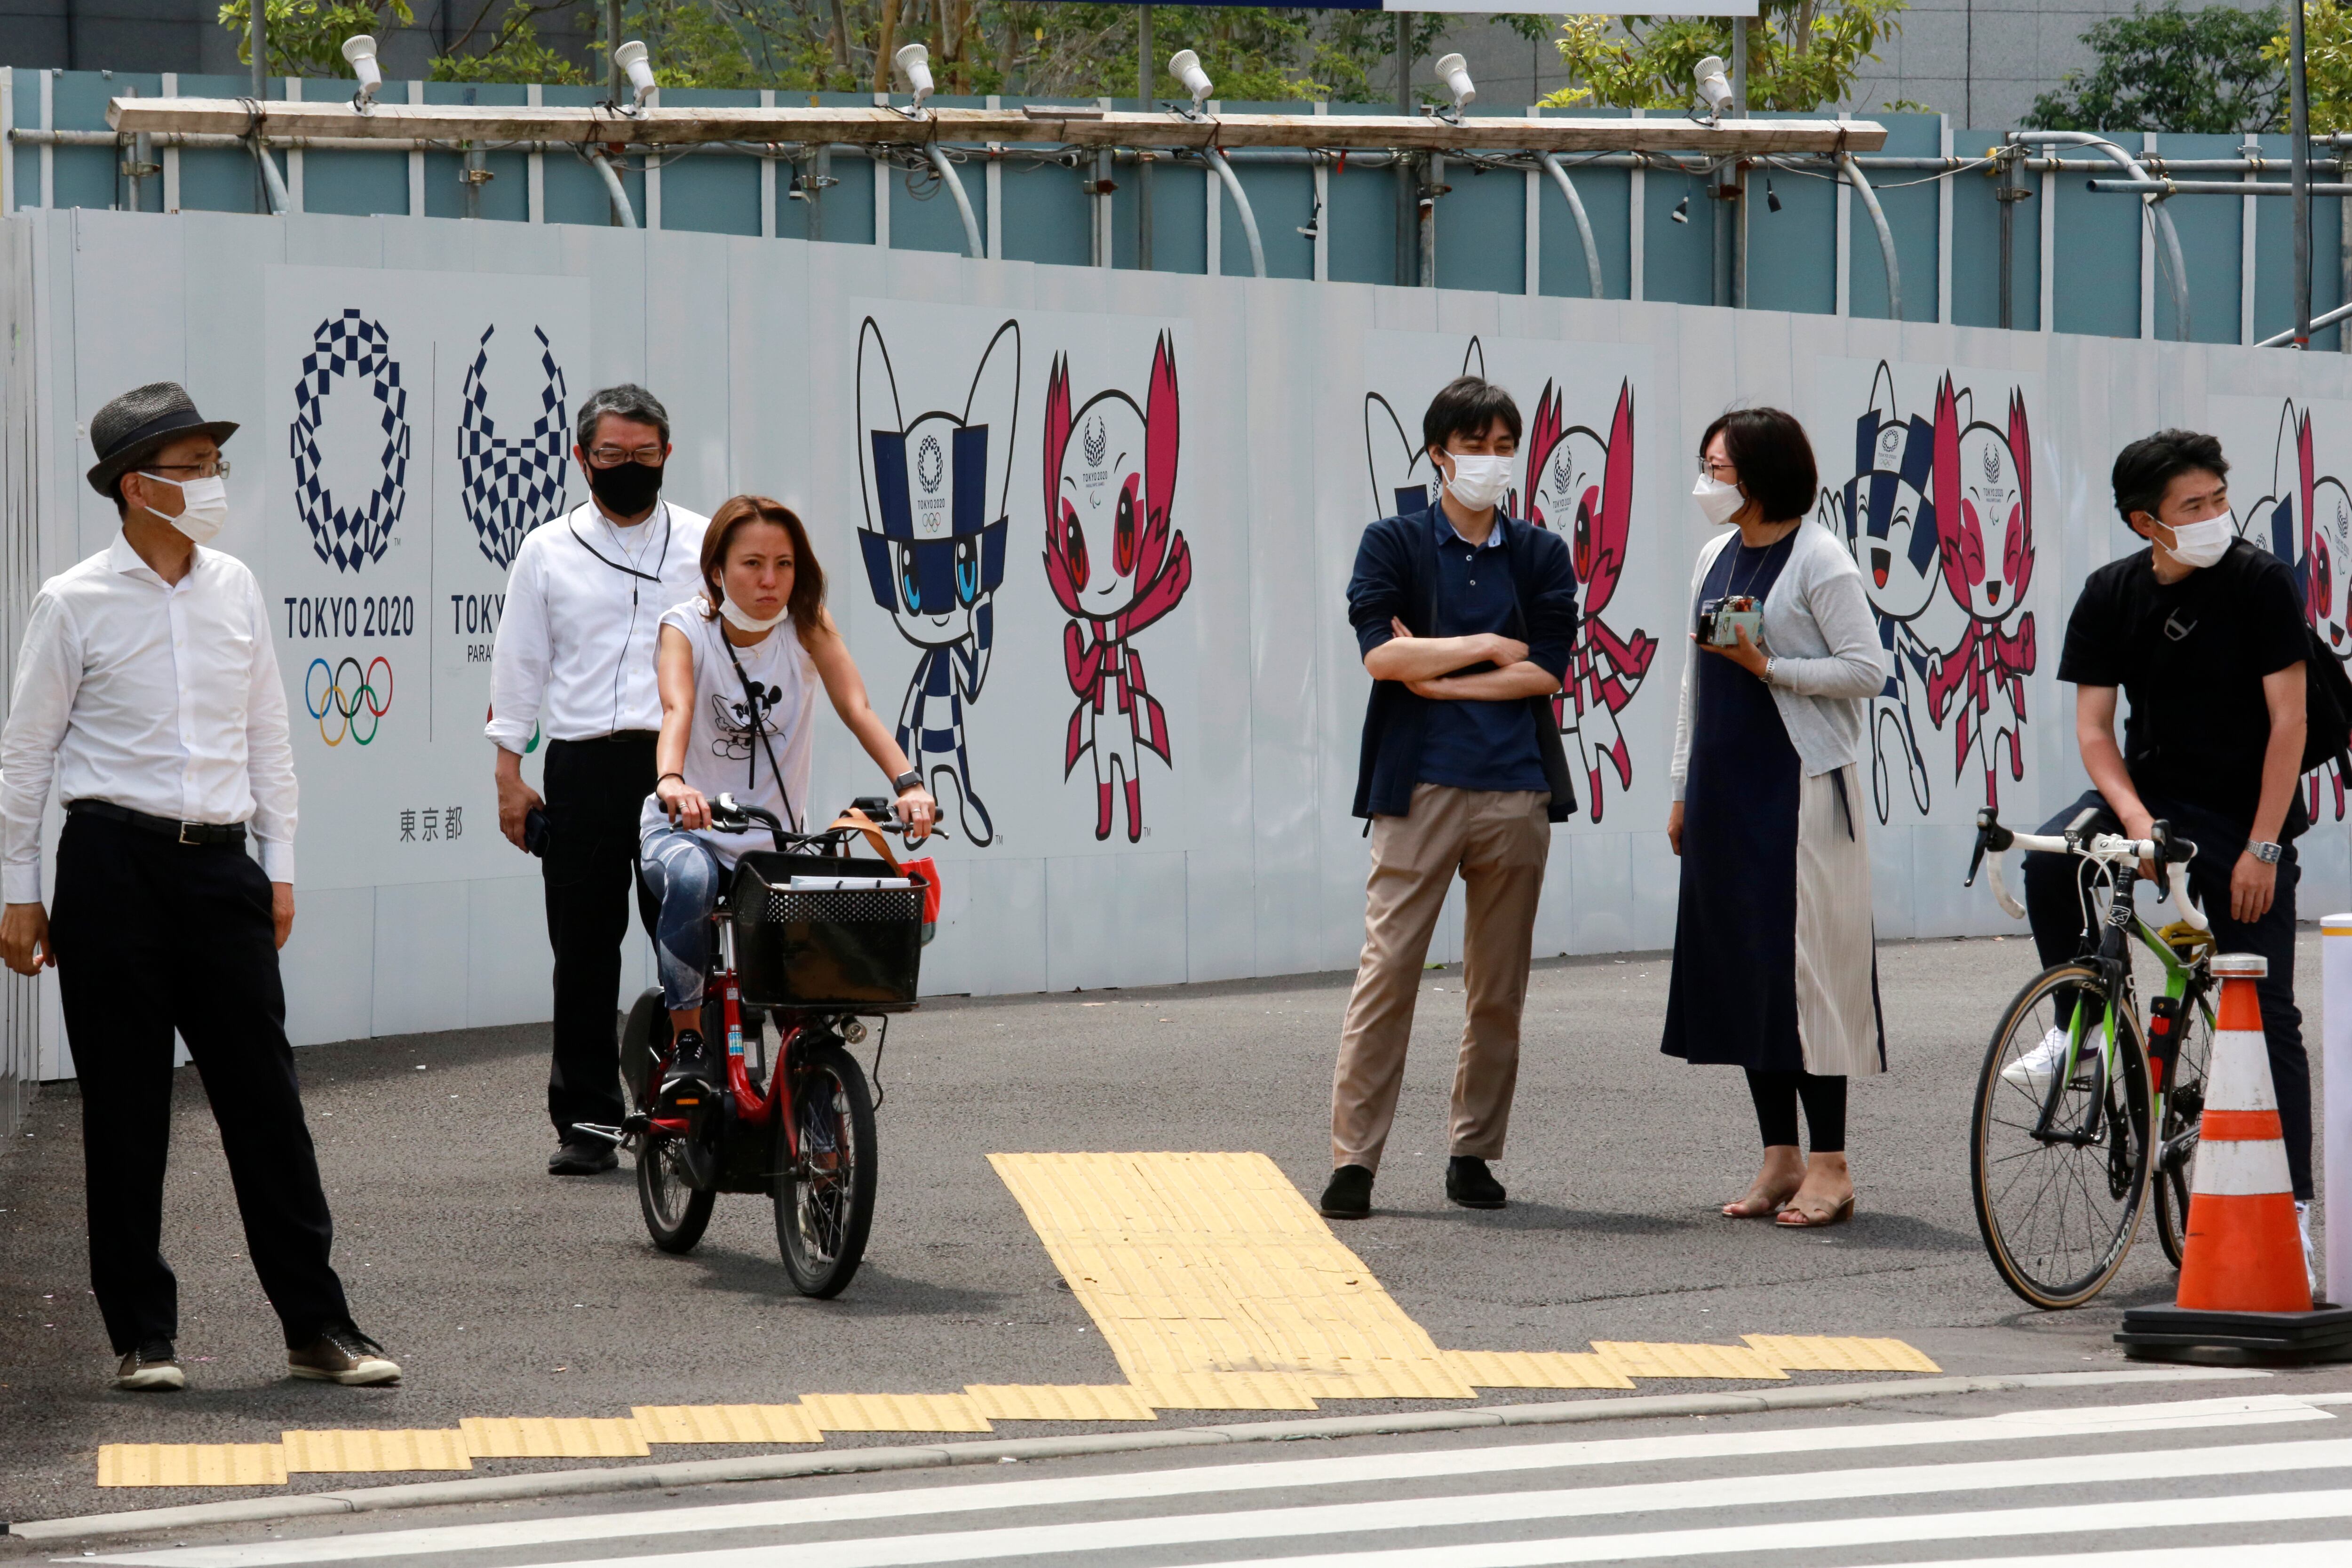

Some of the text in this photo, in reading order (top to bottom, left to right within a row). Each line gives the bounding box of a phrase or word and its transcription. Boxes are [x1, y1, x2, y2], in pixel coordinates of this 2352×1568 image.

[1083, 471, 1108, 482] TOKYO 2020
[1983, 487, 2003, 497] TOKYO 2020
[918, 498, 945, 509] TOKYO 2020
[1553, 499, 1564, 508] TOKYO
[394, 538, 401, 546] TM
[285, 596, 413, 638] TOKYO 2020
[451, 594, 506, 634] TOKY
[400, 806, 462, 843] 東京都
[1143, 827, 1151, 837] TM
[995, 835, 1003, 845] TM
[2102, 1223, 2130, 1269] OVAL
